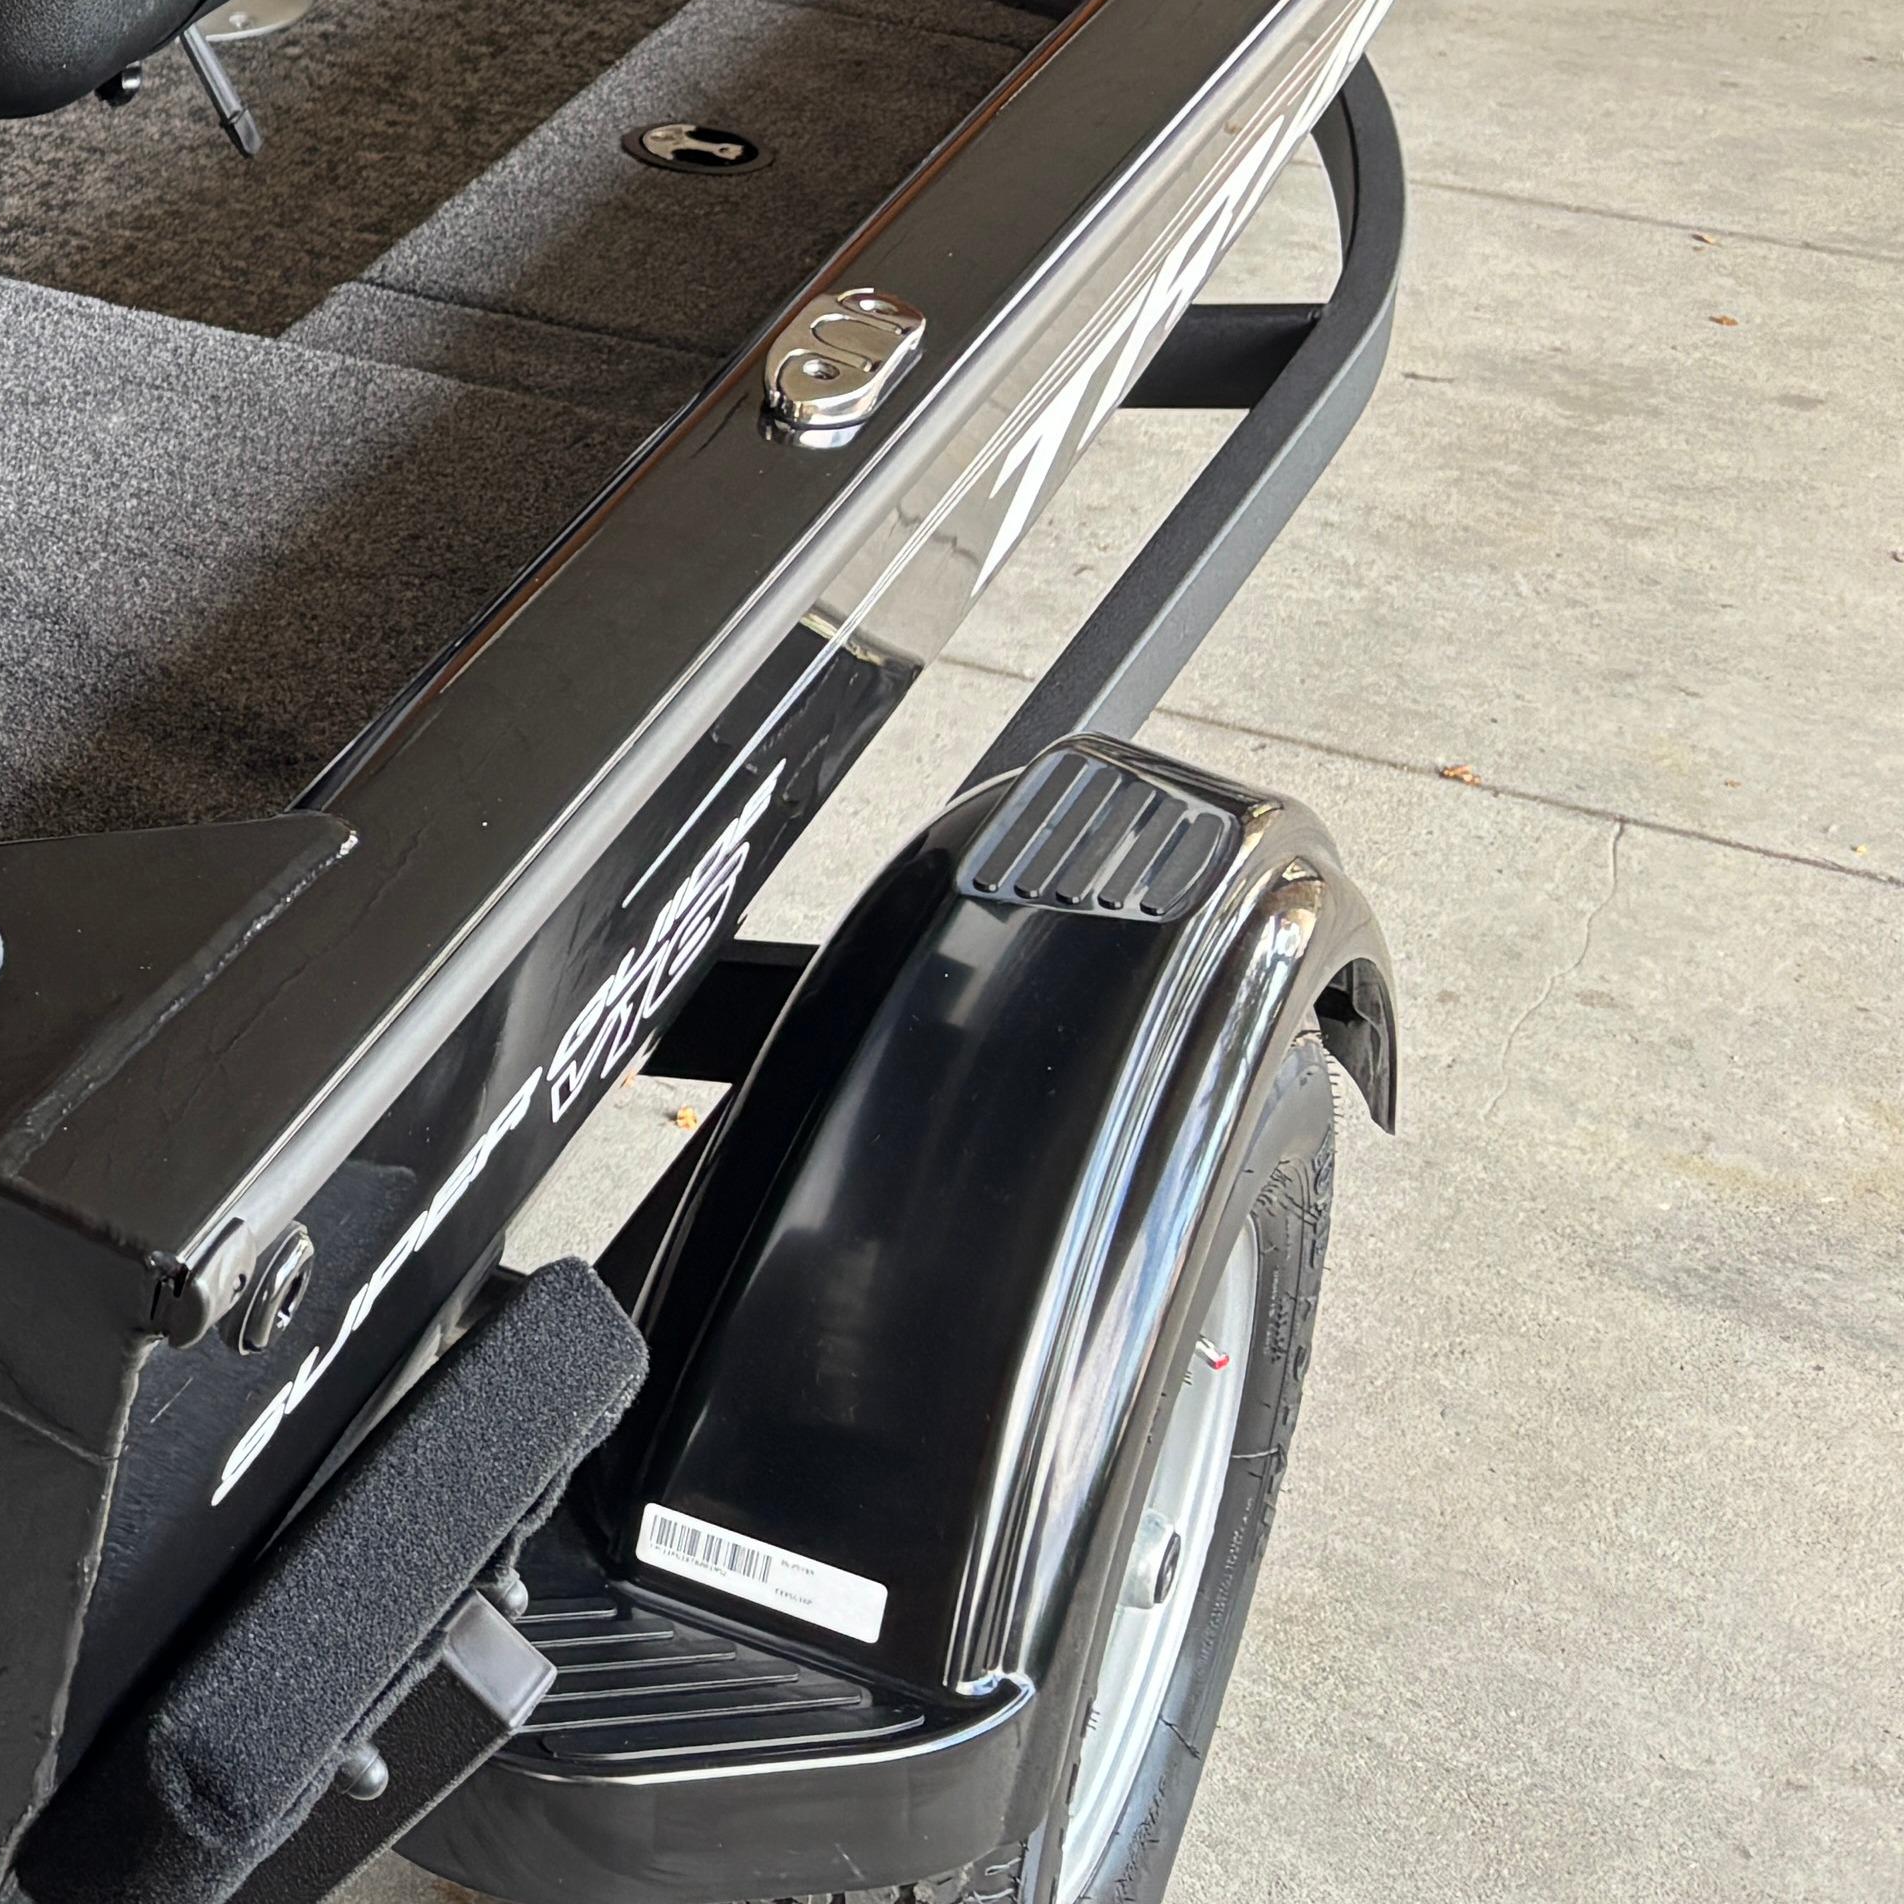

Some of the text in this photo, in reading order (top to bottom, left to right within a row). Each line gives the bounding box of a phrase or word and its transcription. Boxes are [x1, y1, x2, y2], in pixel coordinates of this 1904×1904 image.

[211, 758, 786, 1507] SUPER GUIDE
[551, 842, 750, 1123] V16
